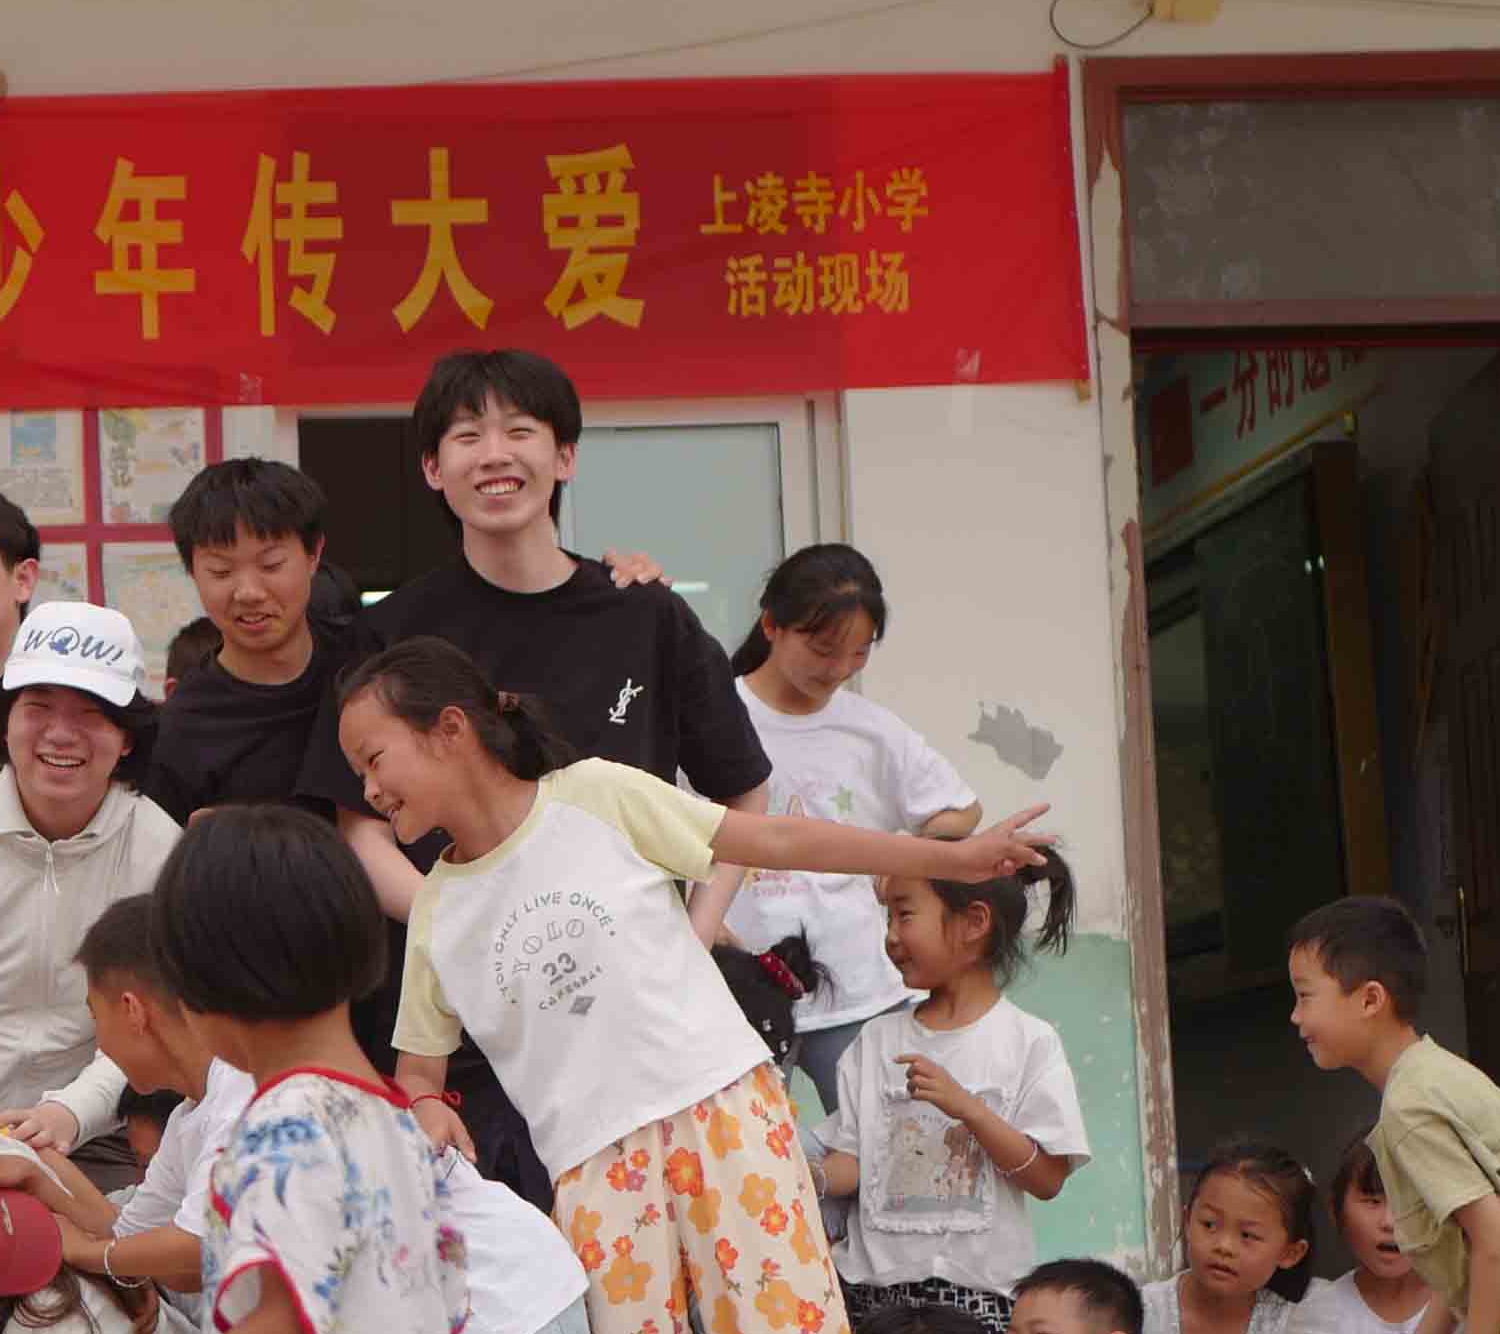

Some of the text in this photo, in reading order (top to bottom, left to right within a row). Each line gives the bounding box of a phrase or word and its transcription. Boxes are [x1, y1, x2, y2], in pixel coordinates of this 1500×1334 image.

[700, 168, 930, 235] 上凌寺小学
[726, 250, 911, 317] 活动现场
[494, 909, 520, 955] ONLY
[522, 891, 561, 914] LIVE
[569, 891, 613, 928] ONCE
[541, 952, 577, 987] 23
